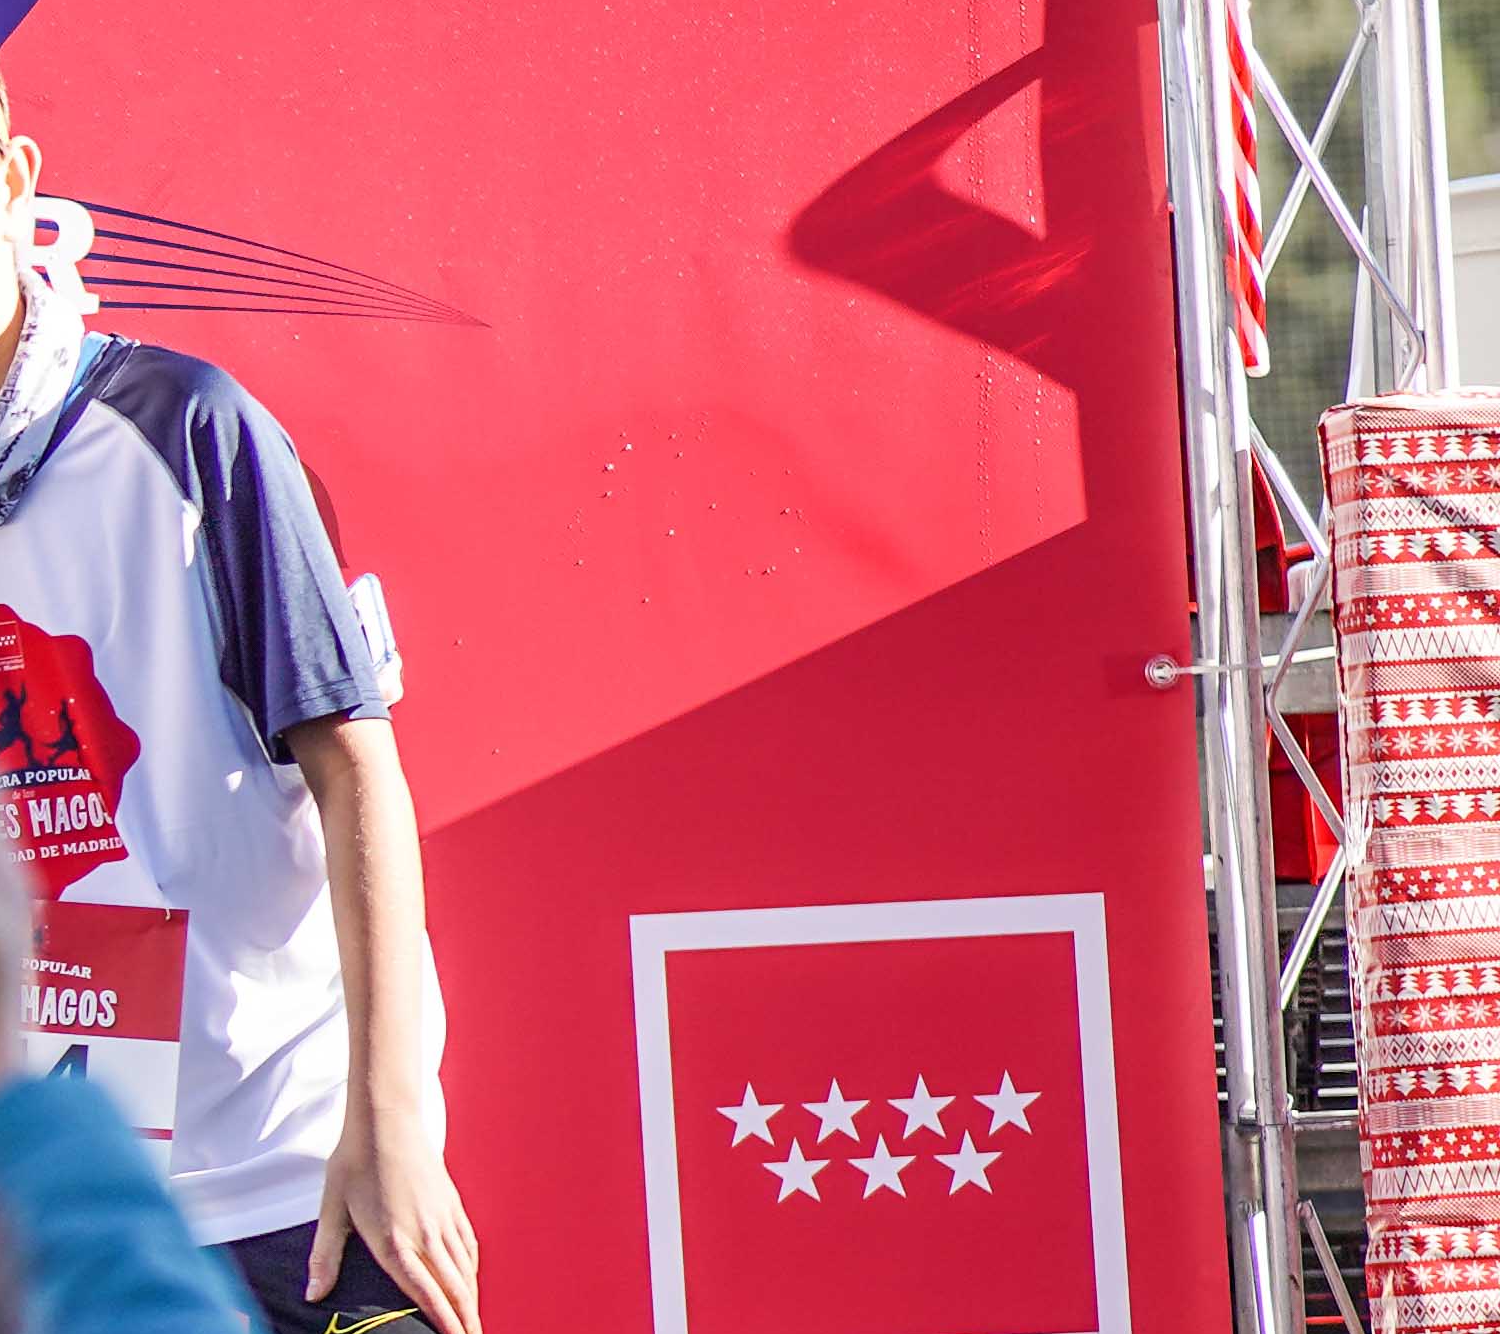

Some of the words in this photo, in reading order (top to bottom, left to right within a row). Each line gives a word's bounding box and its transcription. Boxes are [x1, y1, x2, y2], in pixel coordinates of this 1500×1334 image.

[40, 845, 59, 858] DE
[63, 836, 122, 856] MADRID
[21, 958, 92, 979] POPULAR
[20, 985, 118, 1028] MAGOS
